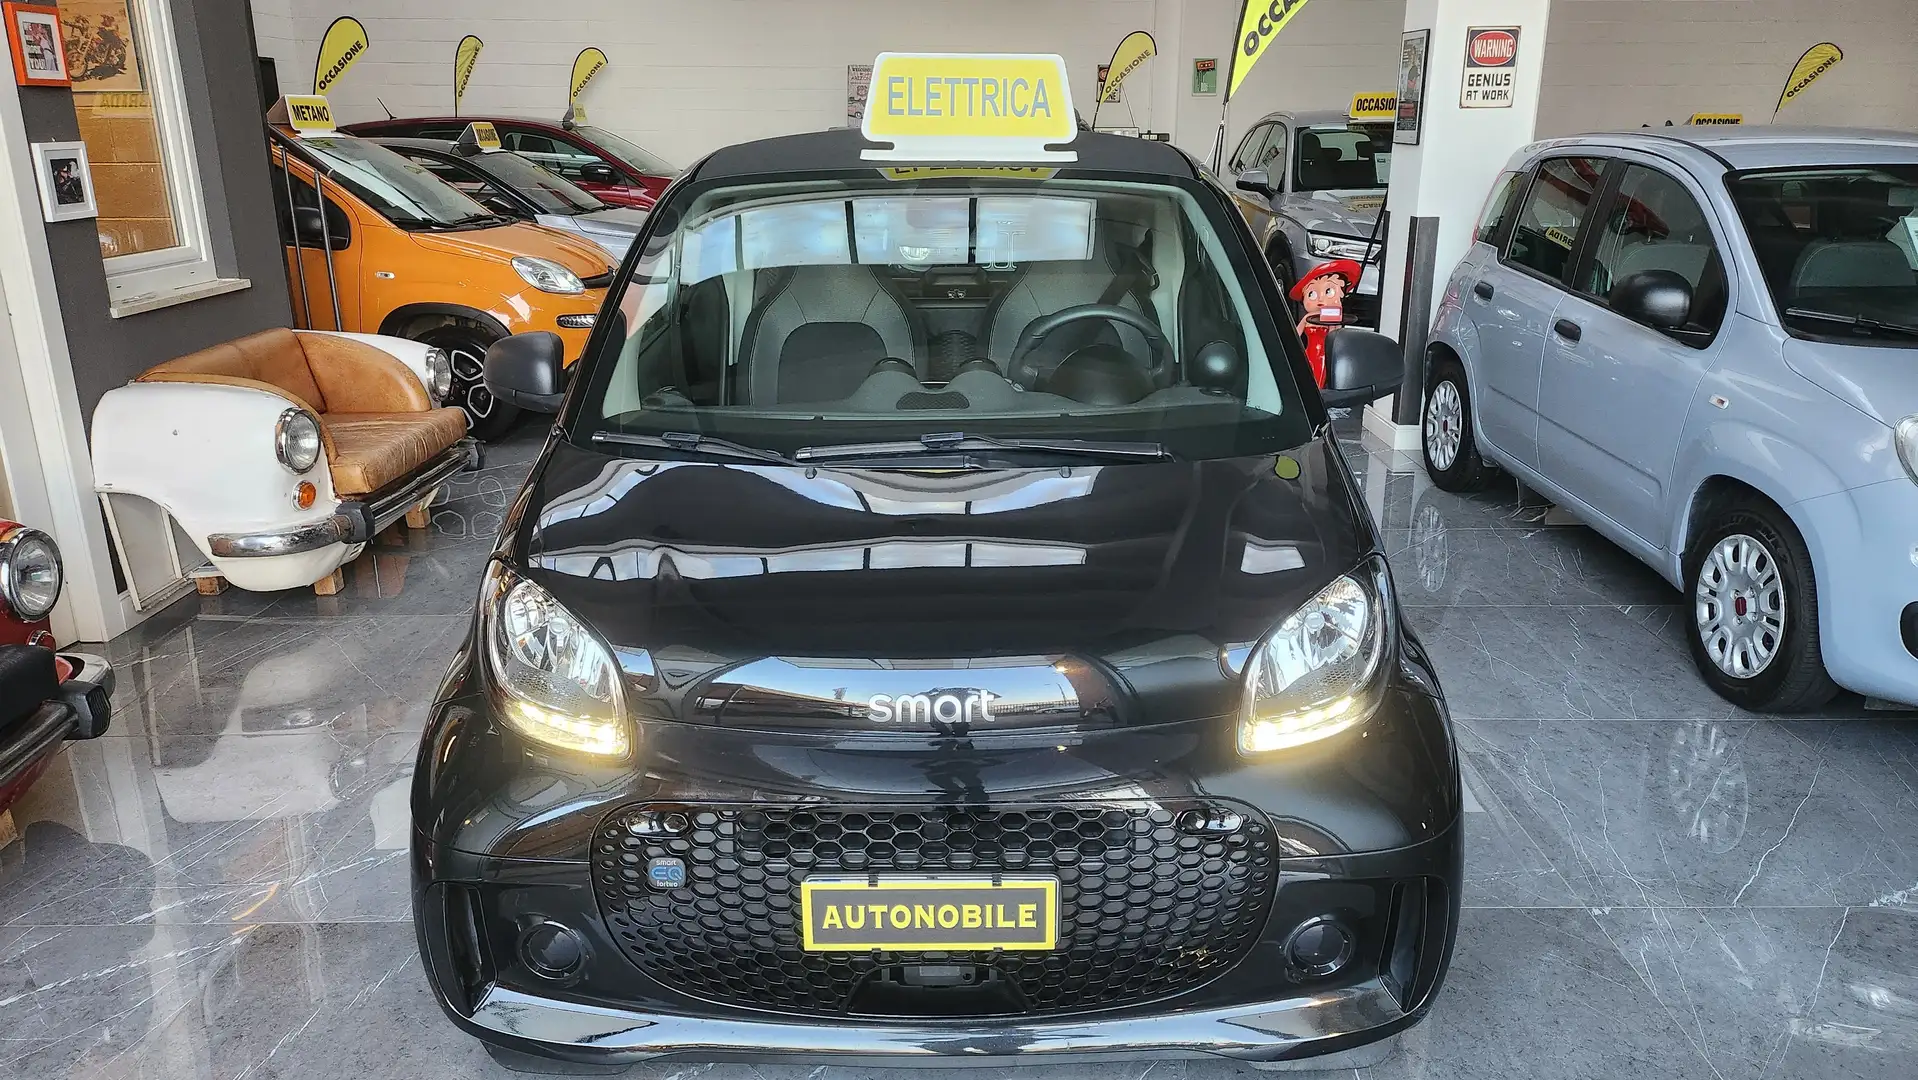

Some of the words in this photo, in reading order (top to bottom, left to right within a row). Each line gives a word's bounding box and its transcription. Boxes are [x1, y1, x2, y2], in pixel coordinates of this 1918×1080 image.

[319, 41, 363, 90] OCCASIONE
[1475, 39, 1513, 58] WARNING
[458, 46, 480, 97] OCCASIONE
[573, 60, 603, 97] OCCASIONE
[1105, 49, 1151, 94] OCCASIONE
[1468, 74, 1511, 87] GENIUS
[1787, 56, 1836, 98] OCCASIONE
[291, 105, 329, 121] METANO
[888, 76, 1051, 117] ELETTRICA
[1466, 90, 1478, 101] AT
[1482, 90, 1509, 101] WORK
[868, 690, 995, 723] smart
[822, 903, 1037, 930] AUTONOBILE
